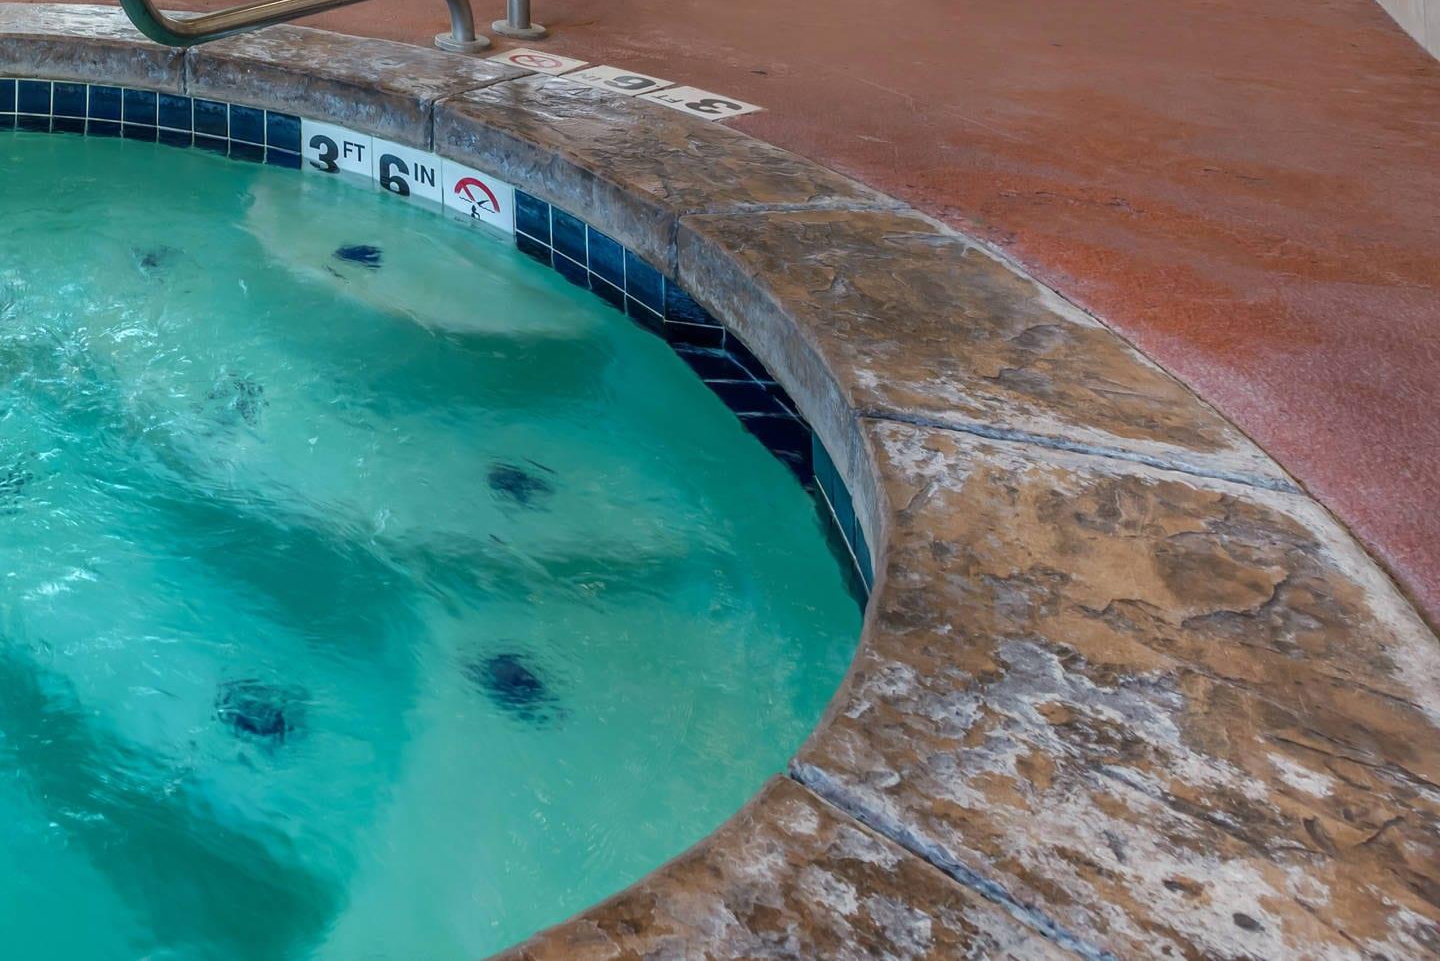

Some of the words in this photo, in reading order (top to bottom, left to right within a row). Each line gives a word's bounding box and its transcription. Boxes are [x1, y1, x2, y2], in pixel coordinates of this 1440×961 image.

[650, 94, 683, 104] FT
[684, 98, 742, 114] 3
[310, 134, 339, 173] 3
[343, 140, 365, 163] FT
[379, 153, 410, 196] 6
[414, 162, 435, 187] IN
